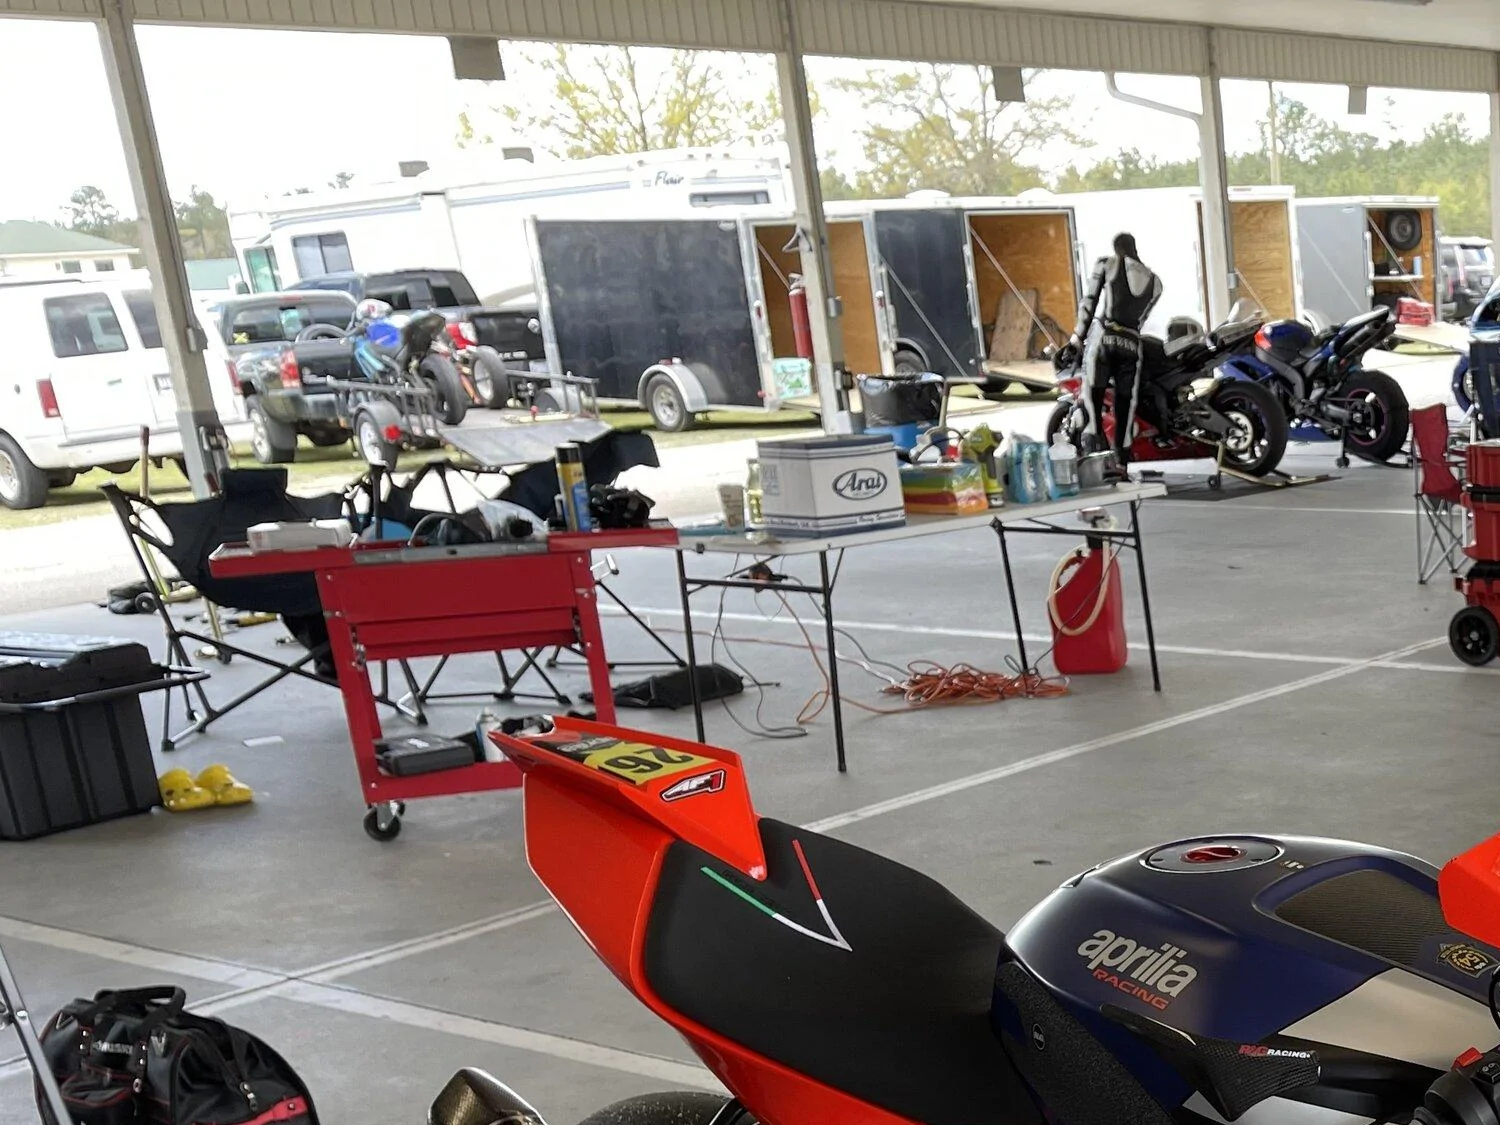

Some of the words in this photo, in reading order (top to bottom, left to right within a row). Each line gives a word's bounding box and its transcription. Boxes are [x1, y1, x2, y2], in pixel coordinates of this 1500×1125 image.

[840, 472, 882, 493] Arai
[1077, 929, 1198, 998] aprilia
[1092, 968, 1169, 1011] RACING
[1267, 1048, 1307, 1059] RACING
